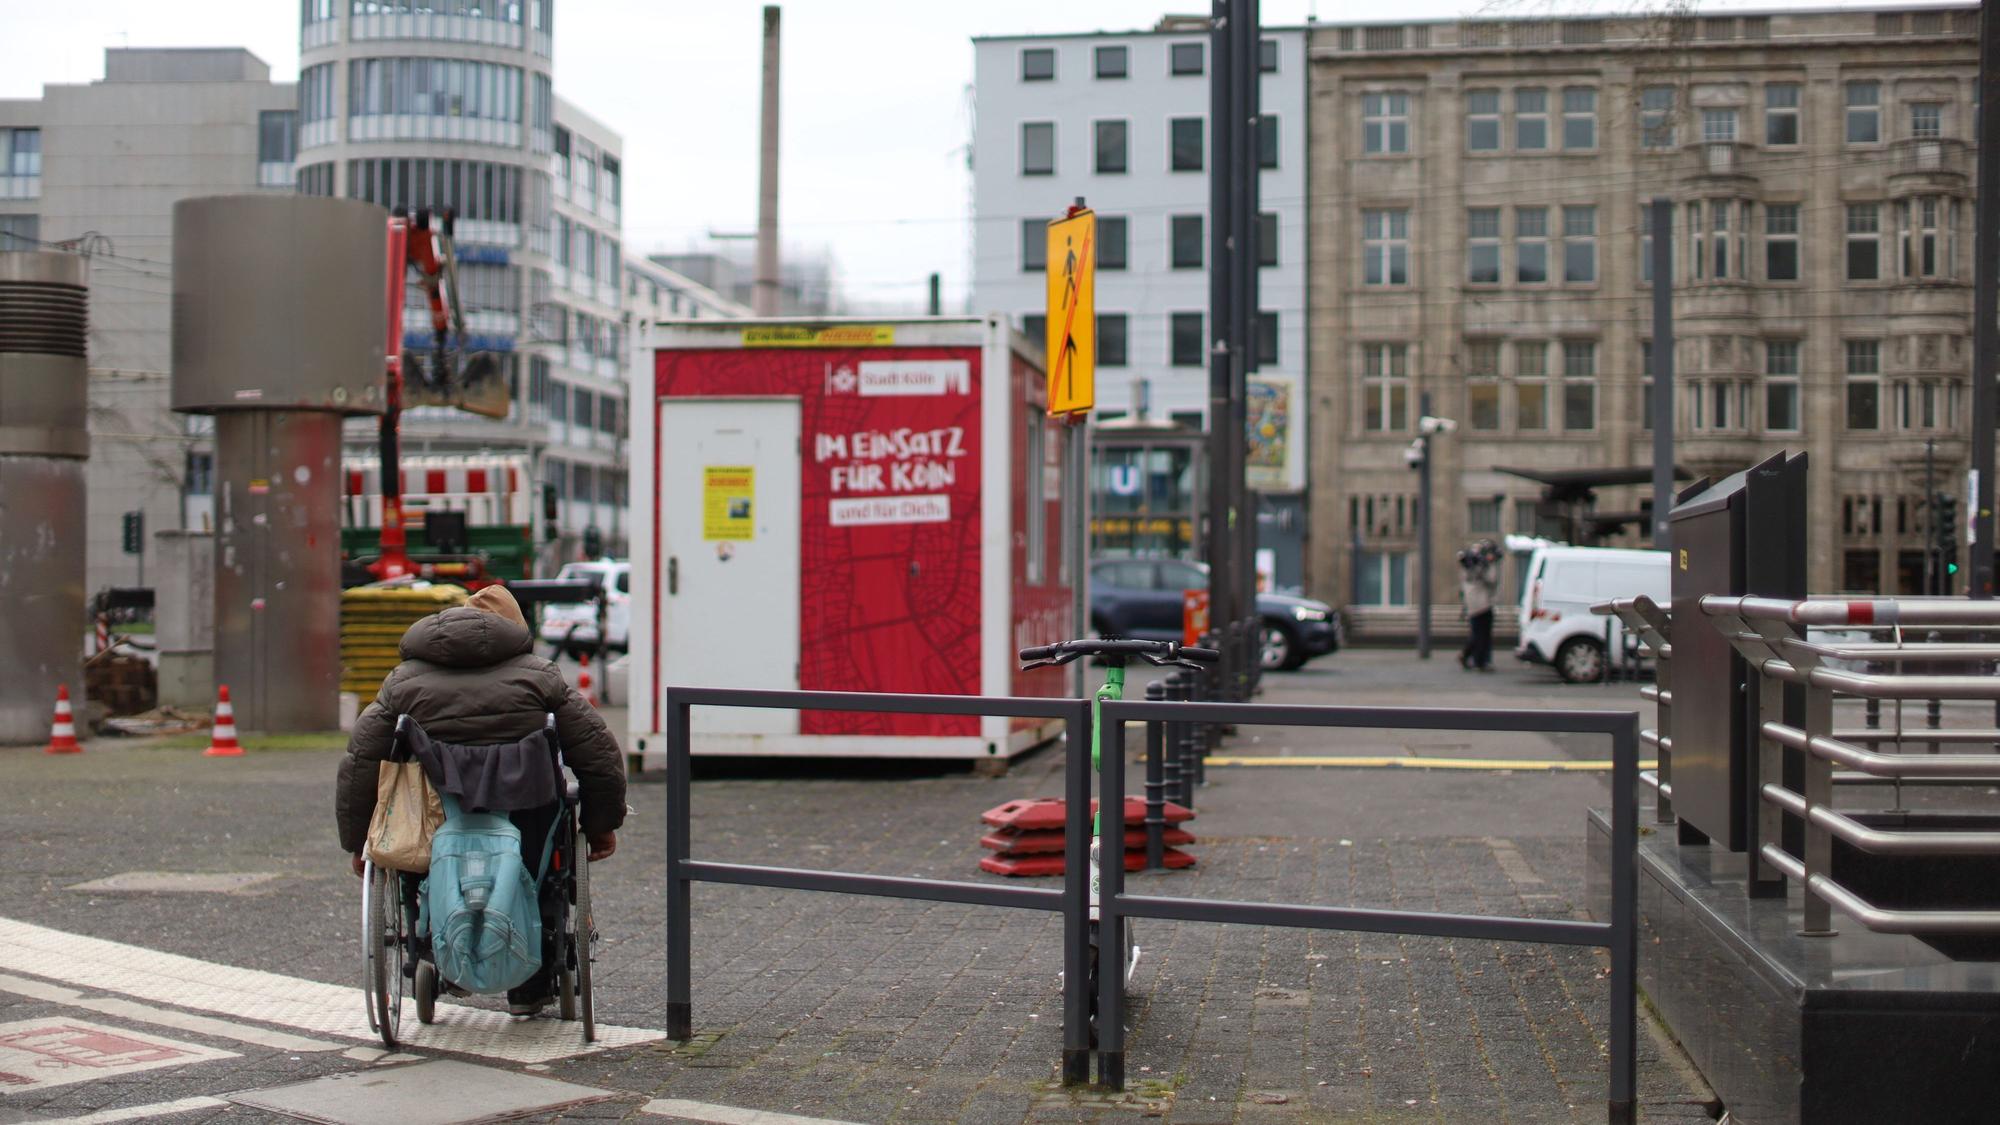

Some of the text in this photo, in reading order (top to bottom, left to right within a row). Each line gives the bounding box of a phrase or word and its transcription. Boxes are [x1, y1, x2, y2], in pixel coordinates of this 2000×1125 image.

[815, 432, 848, 463] IM
[830, 460, 886, 492] FÜR
[1112, 465, 1137, 495] U
[839, 503, 870, 519] und
